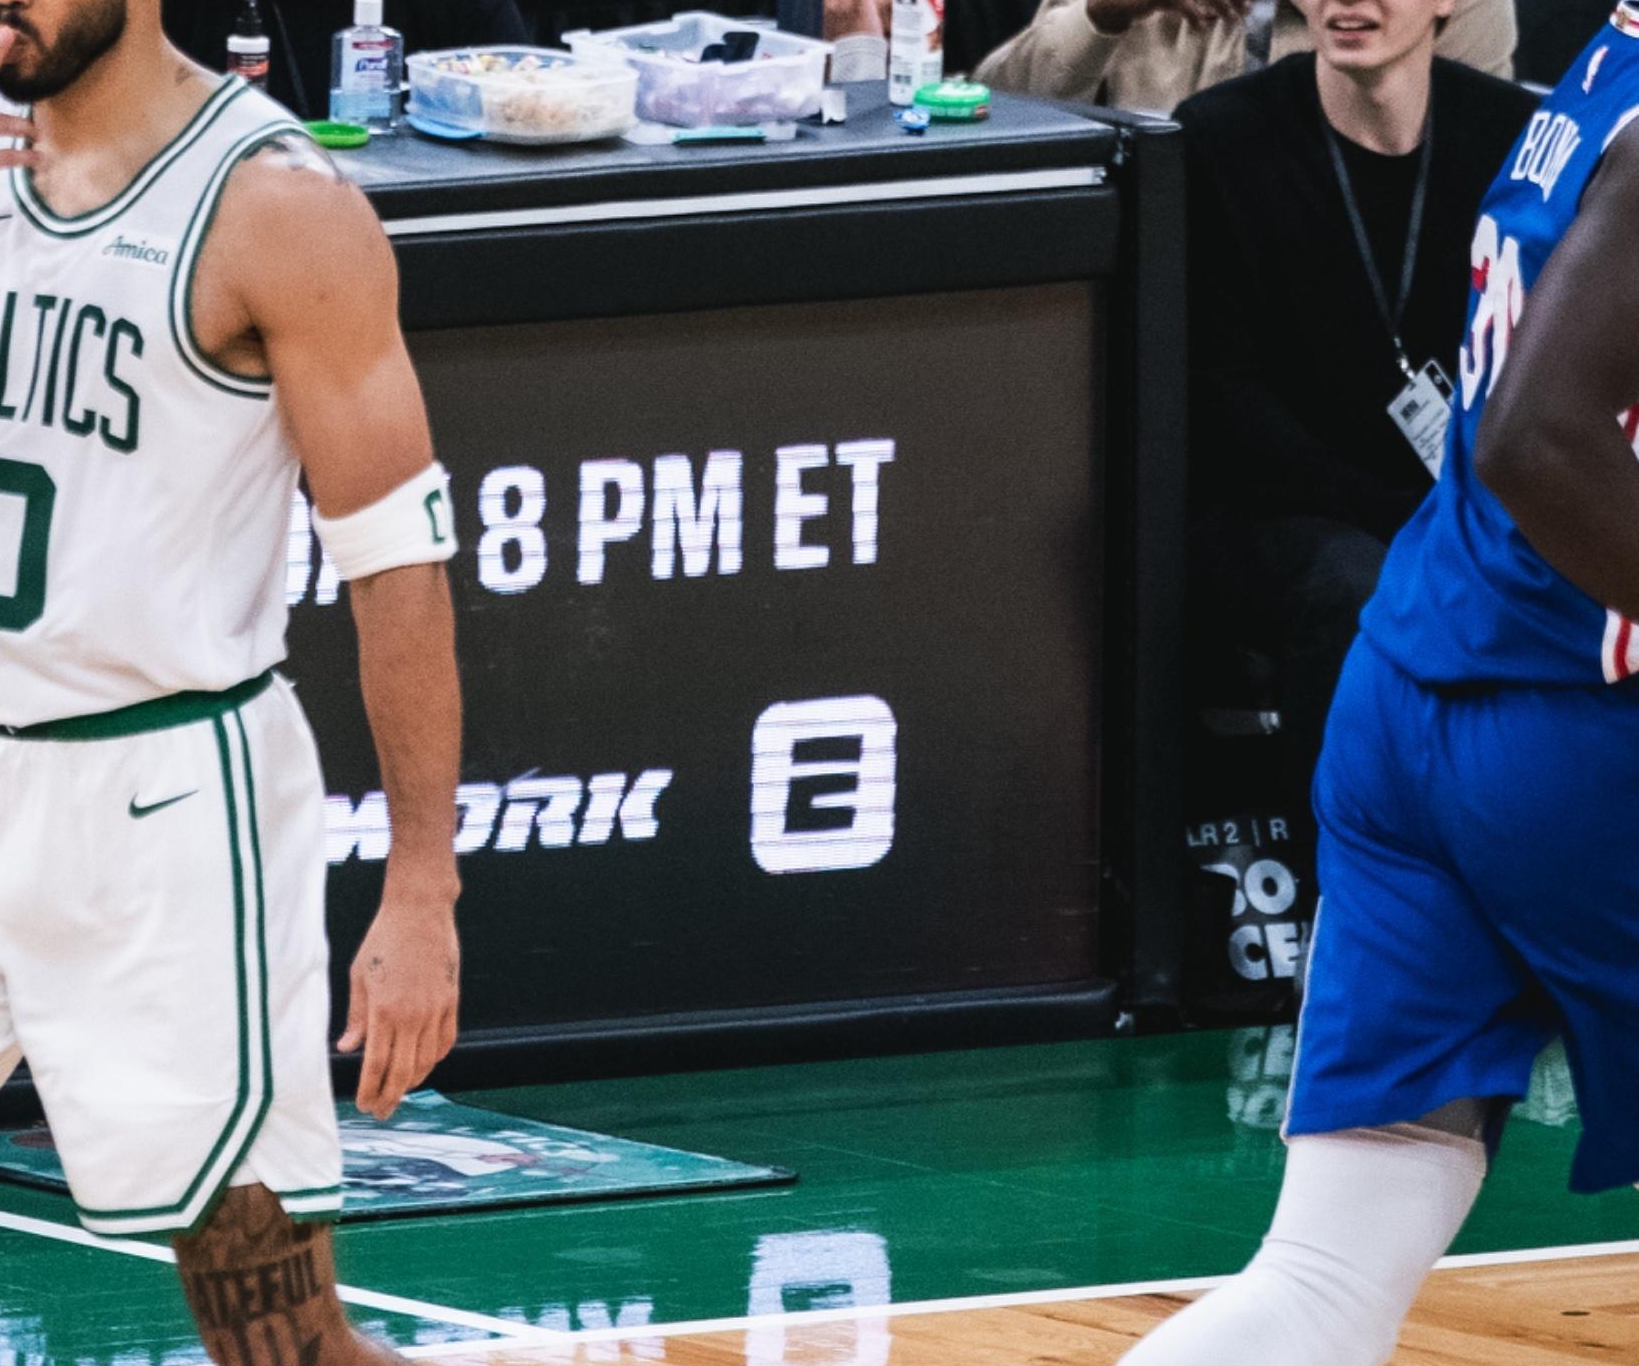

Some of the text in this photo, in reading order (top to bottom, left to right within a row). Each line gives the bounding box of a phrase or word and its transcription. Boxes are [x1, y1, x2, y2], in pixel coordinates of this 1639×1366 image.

[102, 235, 168, 265] Amica
[477, 464, 548, 595] 8
[575, 449, 744, 586] PM
[774, 438, 896, 571] ET
